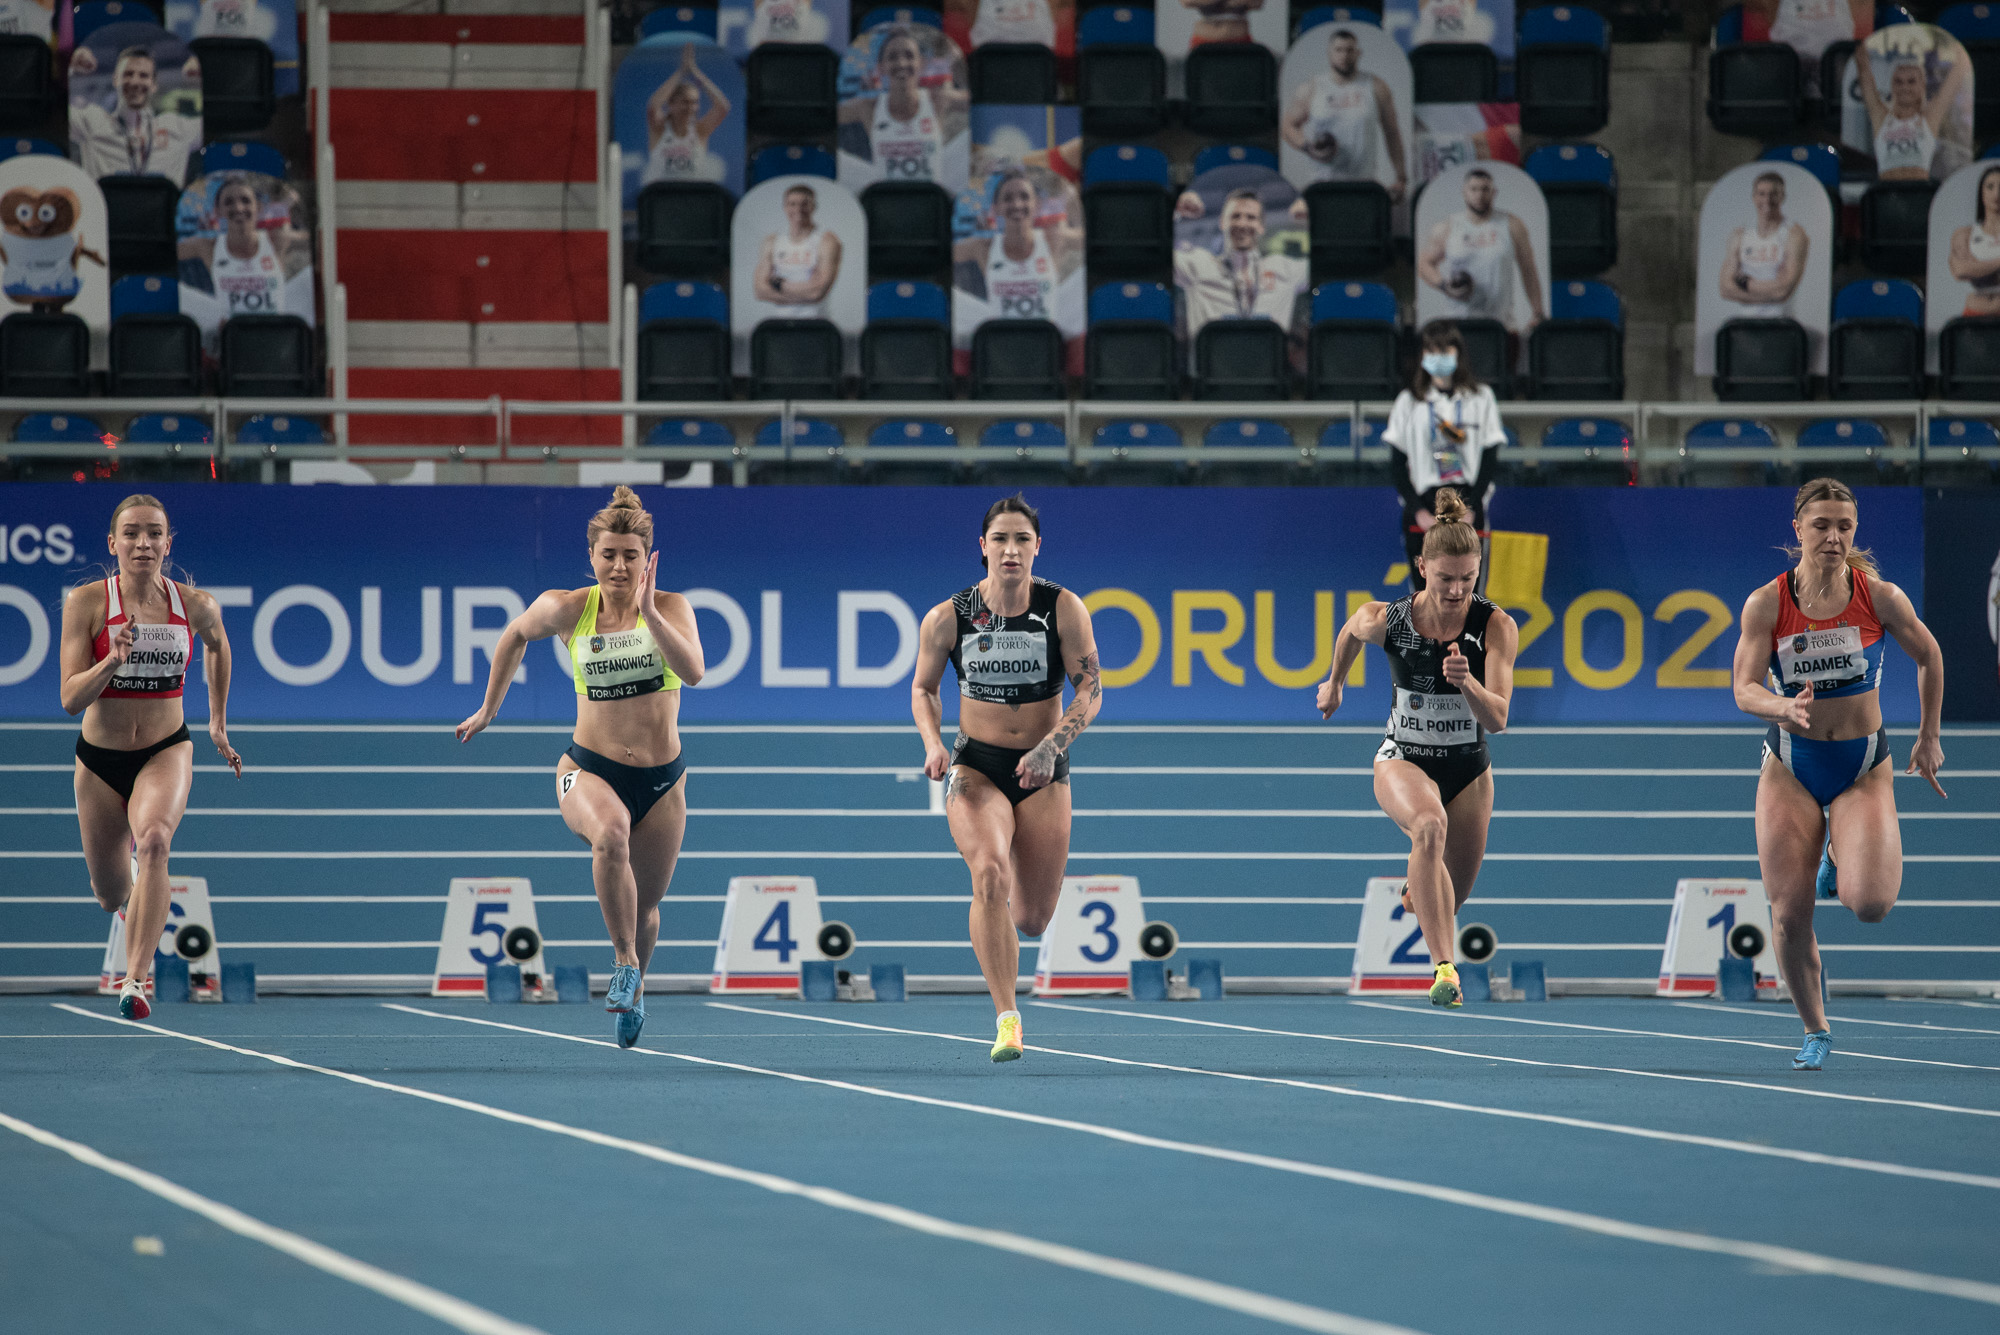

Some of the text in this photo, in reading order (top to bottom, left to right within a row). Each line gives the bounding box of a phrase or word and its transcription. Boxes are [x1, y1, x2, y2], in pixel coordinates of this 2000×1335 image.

[887, 157, 932, 179] POL
[229, 291, 277, 312] POL
[1002, 296, 1047, 317] POL
[142, 630, 175, 641] TORUŃ
[553, 587, 919, 689] OLD
[1488, 589, 1774, 690] 202
[608, 635, 642, 650] TORUŃ
[995, 638, 1031, 650] TORUŃ
[1810, 634, 1846, 649] TORUŃ
[585, 653, 654, 675] STEFANOWICZ
[968, 660, 1041, 674] SWOBODA
[1793, 654, 1854, 675] ADAMEK
[112, 678, 158, 690] TORUŃ 21
[590, 684, 637, 698] TORUŃ 21
[1006, 688, 1019, 697] 21
[1826, 680, 1838, 689] 21
[1426, 700, 1462, 711] TORUŃ
[1400, 714, 1473, 733] DEL PONTE
[1400, 744, 1433, 757] TORUŃ
[1436, 748, 1448, 757] 21
[563, 772, 574, 794] 6
[469, 902, 509, 965] 5
[753, 900, 798, 964] 4
[1080, 901, 1119, 963] 3
[1390, 903, 1431, 964] 2
[1707, 903, 1736, 961] 1
